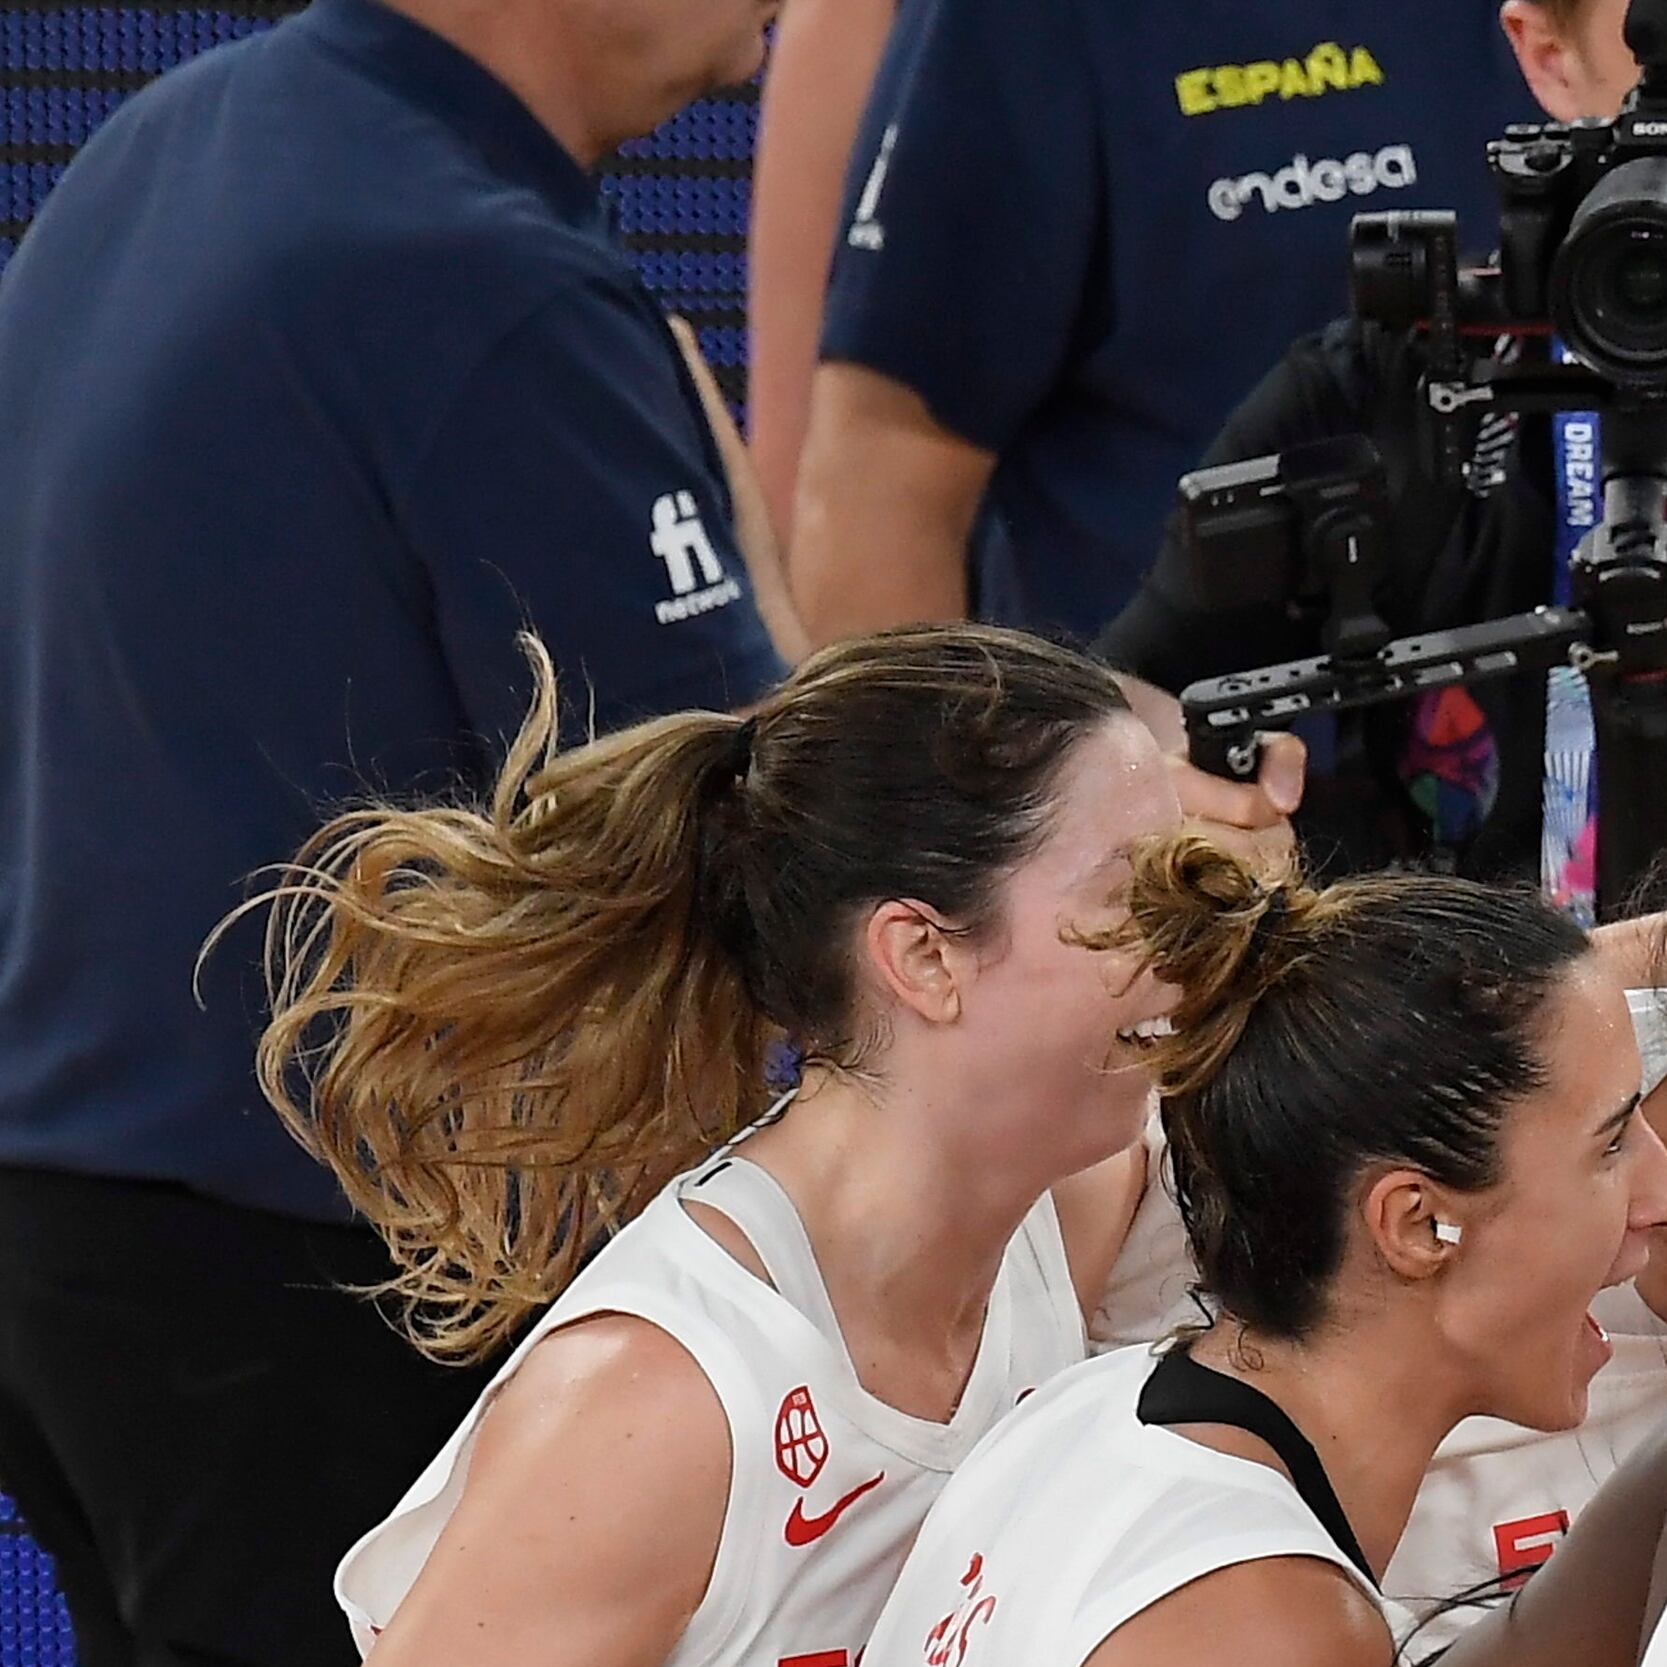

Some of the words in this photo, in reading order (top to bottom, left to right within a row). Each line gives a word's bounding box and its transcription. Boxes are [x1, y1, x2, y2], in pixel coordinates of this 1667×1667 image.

[1175, 42, 1384, 116] ESPAÑA
[1208, 144, 1417, 221] endesa
[1564, 422, 1595, 527] DREAM
